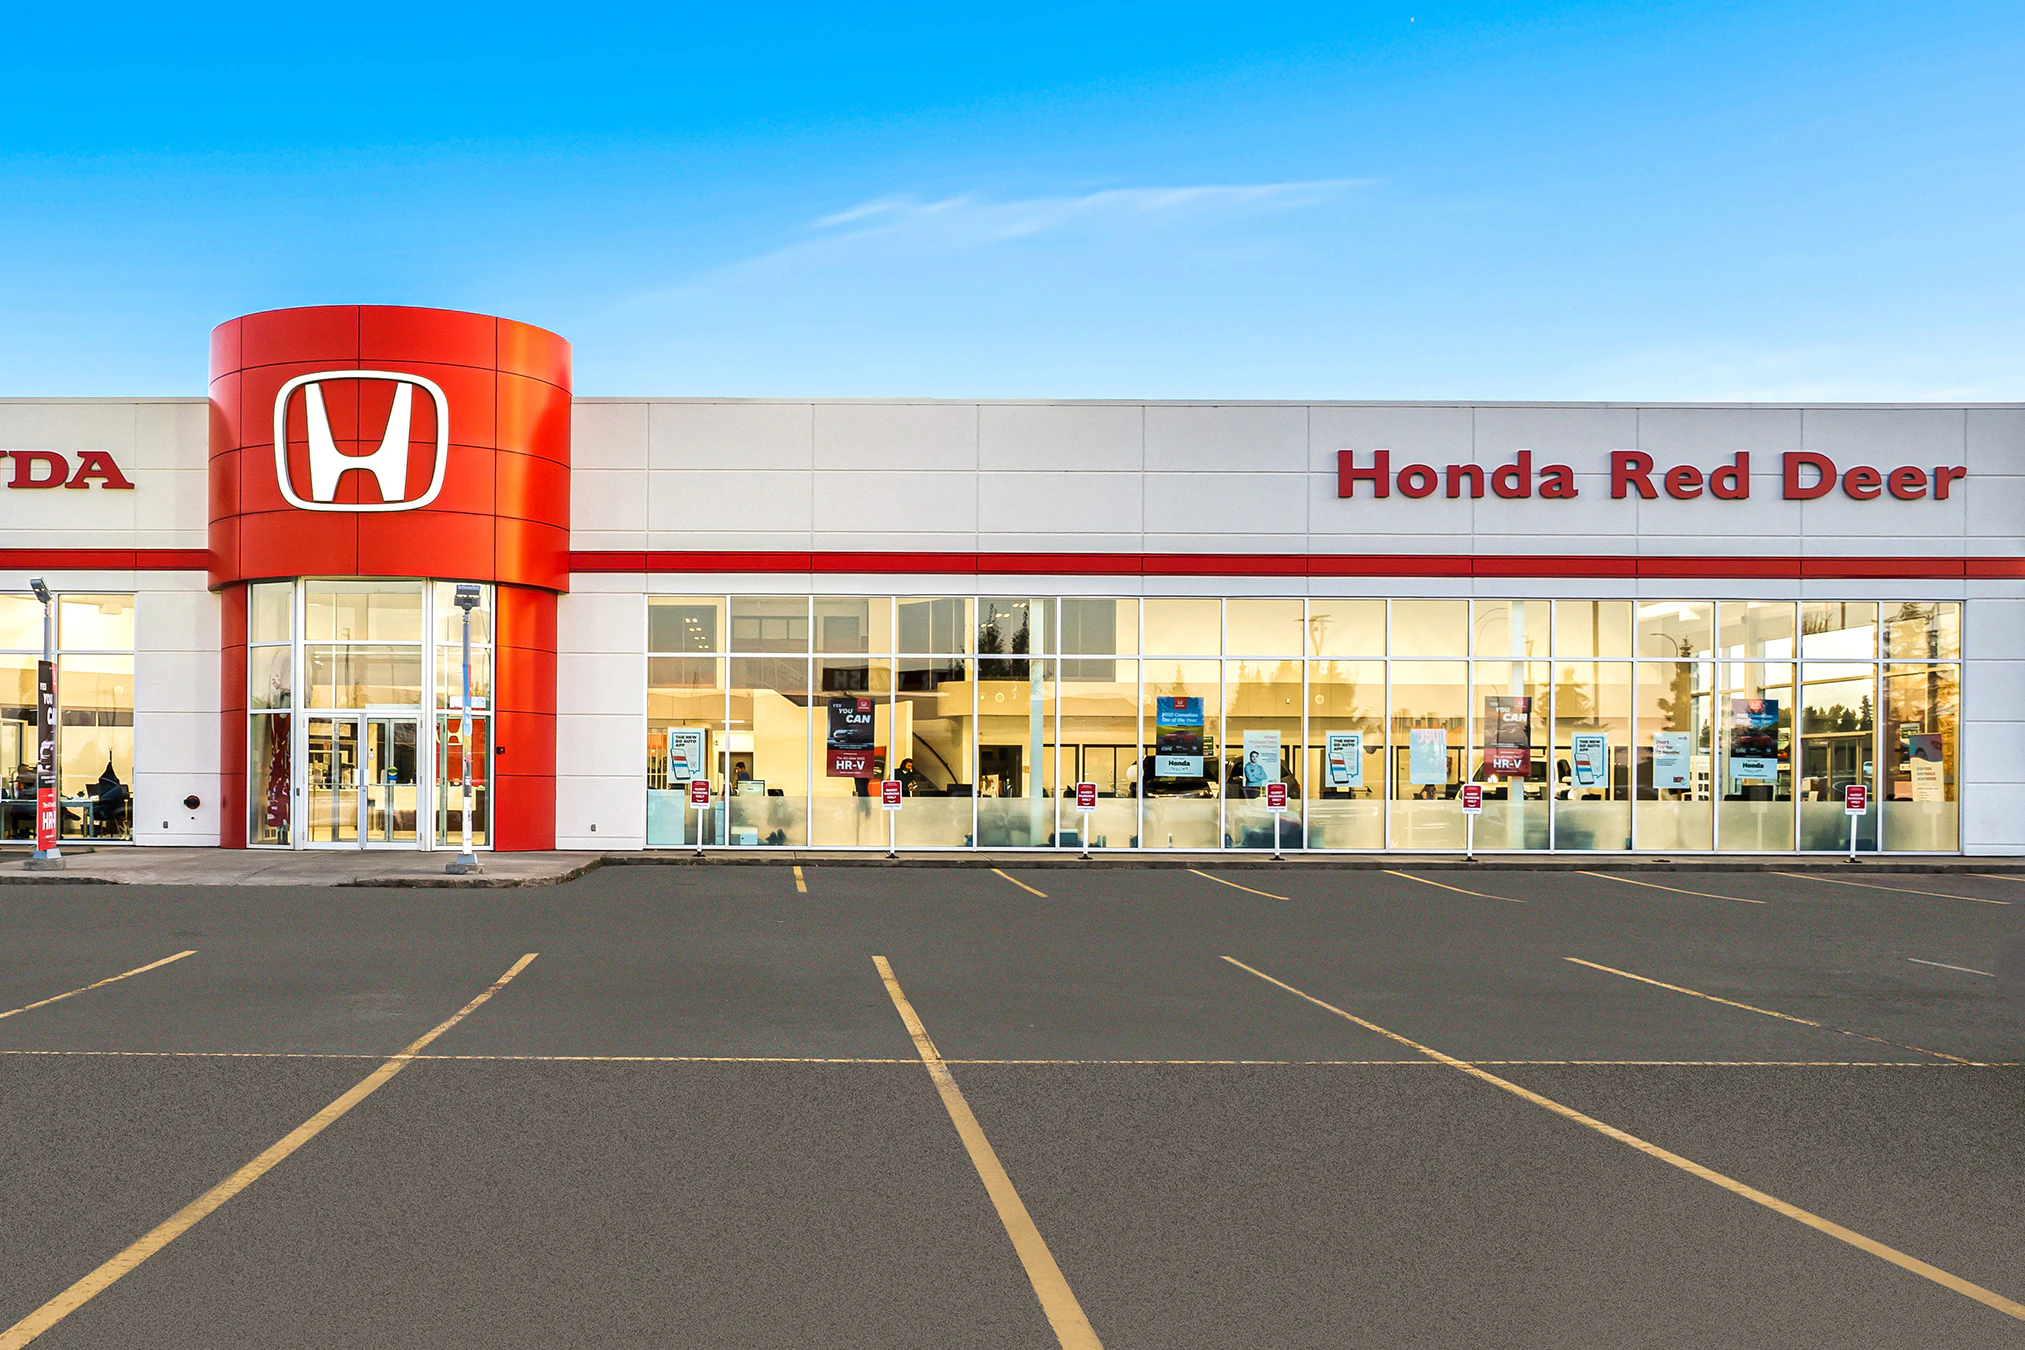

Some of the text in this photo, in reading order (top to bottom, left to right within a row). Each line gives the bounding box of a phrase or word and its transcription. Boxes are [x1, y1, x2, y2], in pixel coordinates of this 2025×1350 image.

[0, 450, 135, 489] DA
[1337, 449, 1967, 499] Honda Red Deer
[845, 714, 871, 724] CAN
[1503, 713, 1528, 722] CAN
[836, 760, 865, 770] HR-V
[1493, 759, 1522, 769] HR-V
